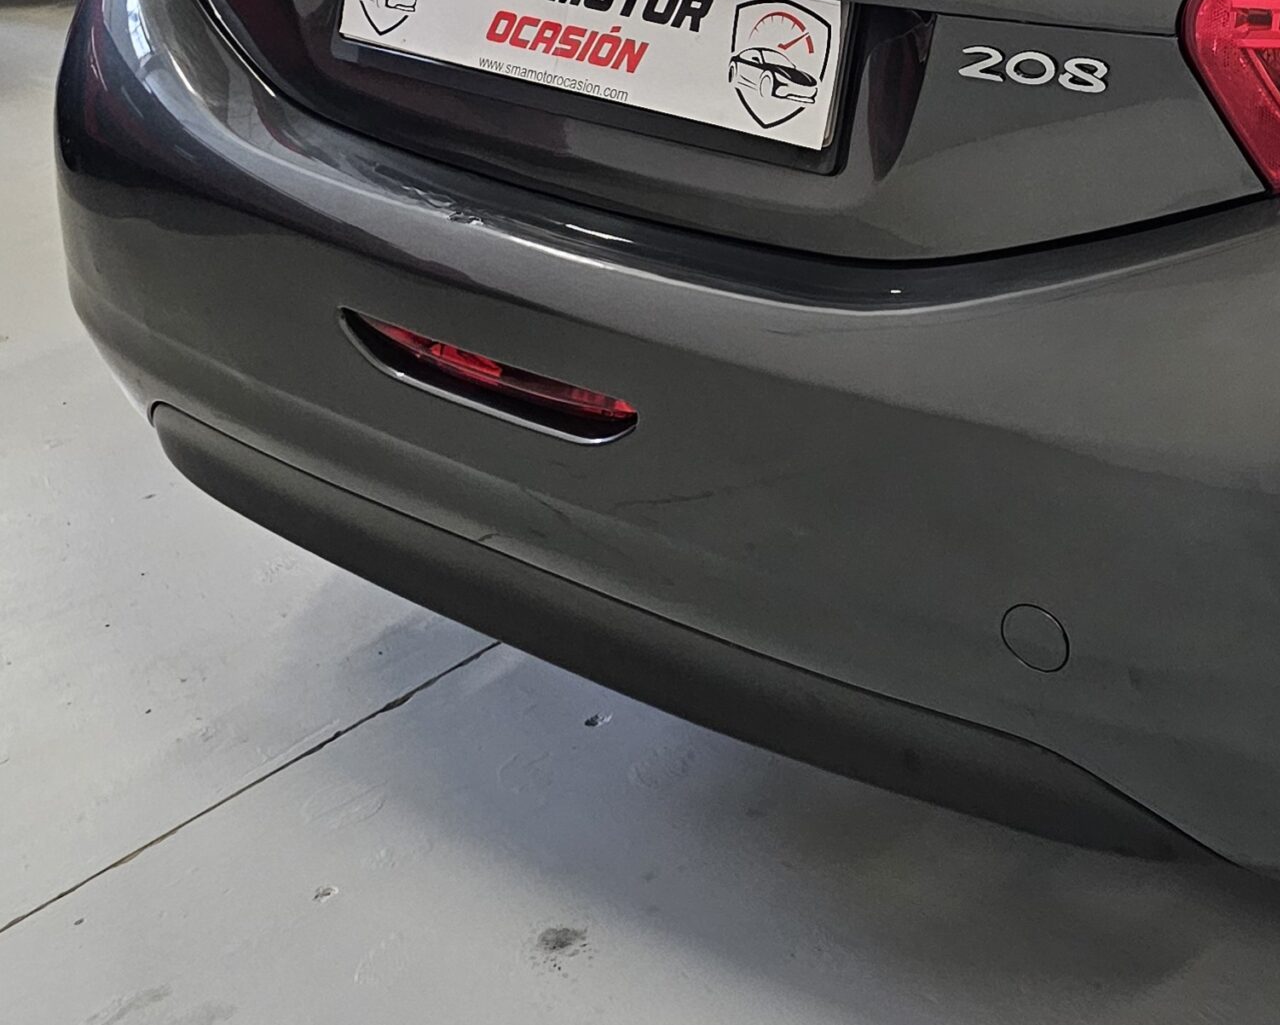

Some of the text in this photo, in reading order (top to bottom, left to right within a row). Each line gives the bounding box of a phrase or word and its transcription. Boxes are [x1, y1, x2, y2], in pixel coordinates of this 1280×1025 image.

[486, 9, 649, 74] OCASIÓN
[478, 57, 629, 102] www.smamotorocasion.com
[958, 45, 1109, 94] 208
